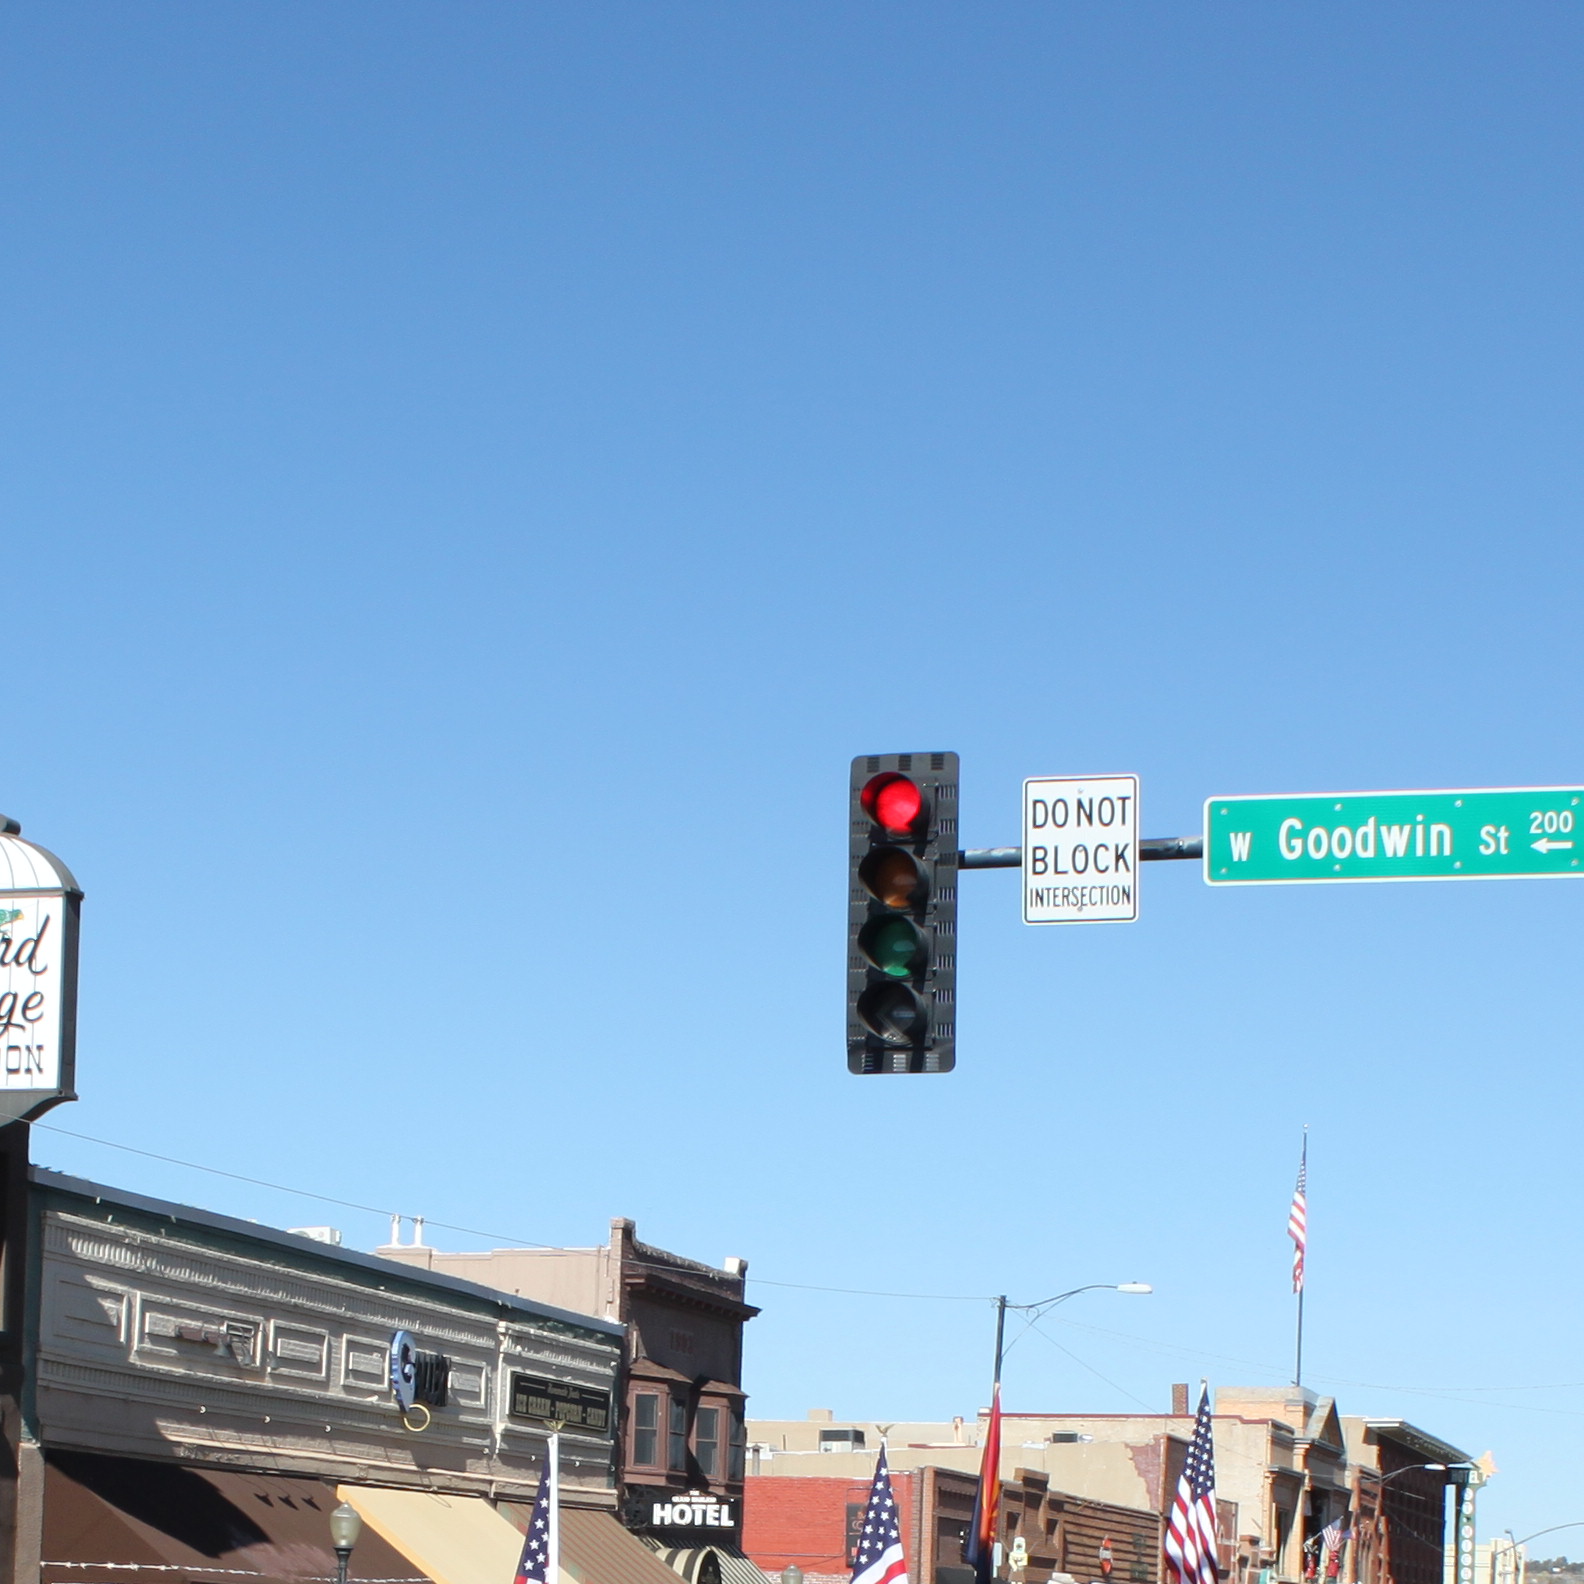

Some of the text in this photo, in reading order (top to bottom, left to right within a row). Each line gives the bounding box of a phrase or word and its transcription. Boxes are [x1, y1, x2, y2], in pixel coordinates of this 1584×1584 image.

[1031, 797, 1131, 830] DO NOT
[1230, 811, 1574, 863] W Goodwin St 200
[1031, 844, 1131, 877] BLOCK
[1029, 884, 1132, 909] INTERSECTION
[652, 1503, 734, 1526] HOTEL
